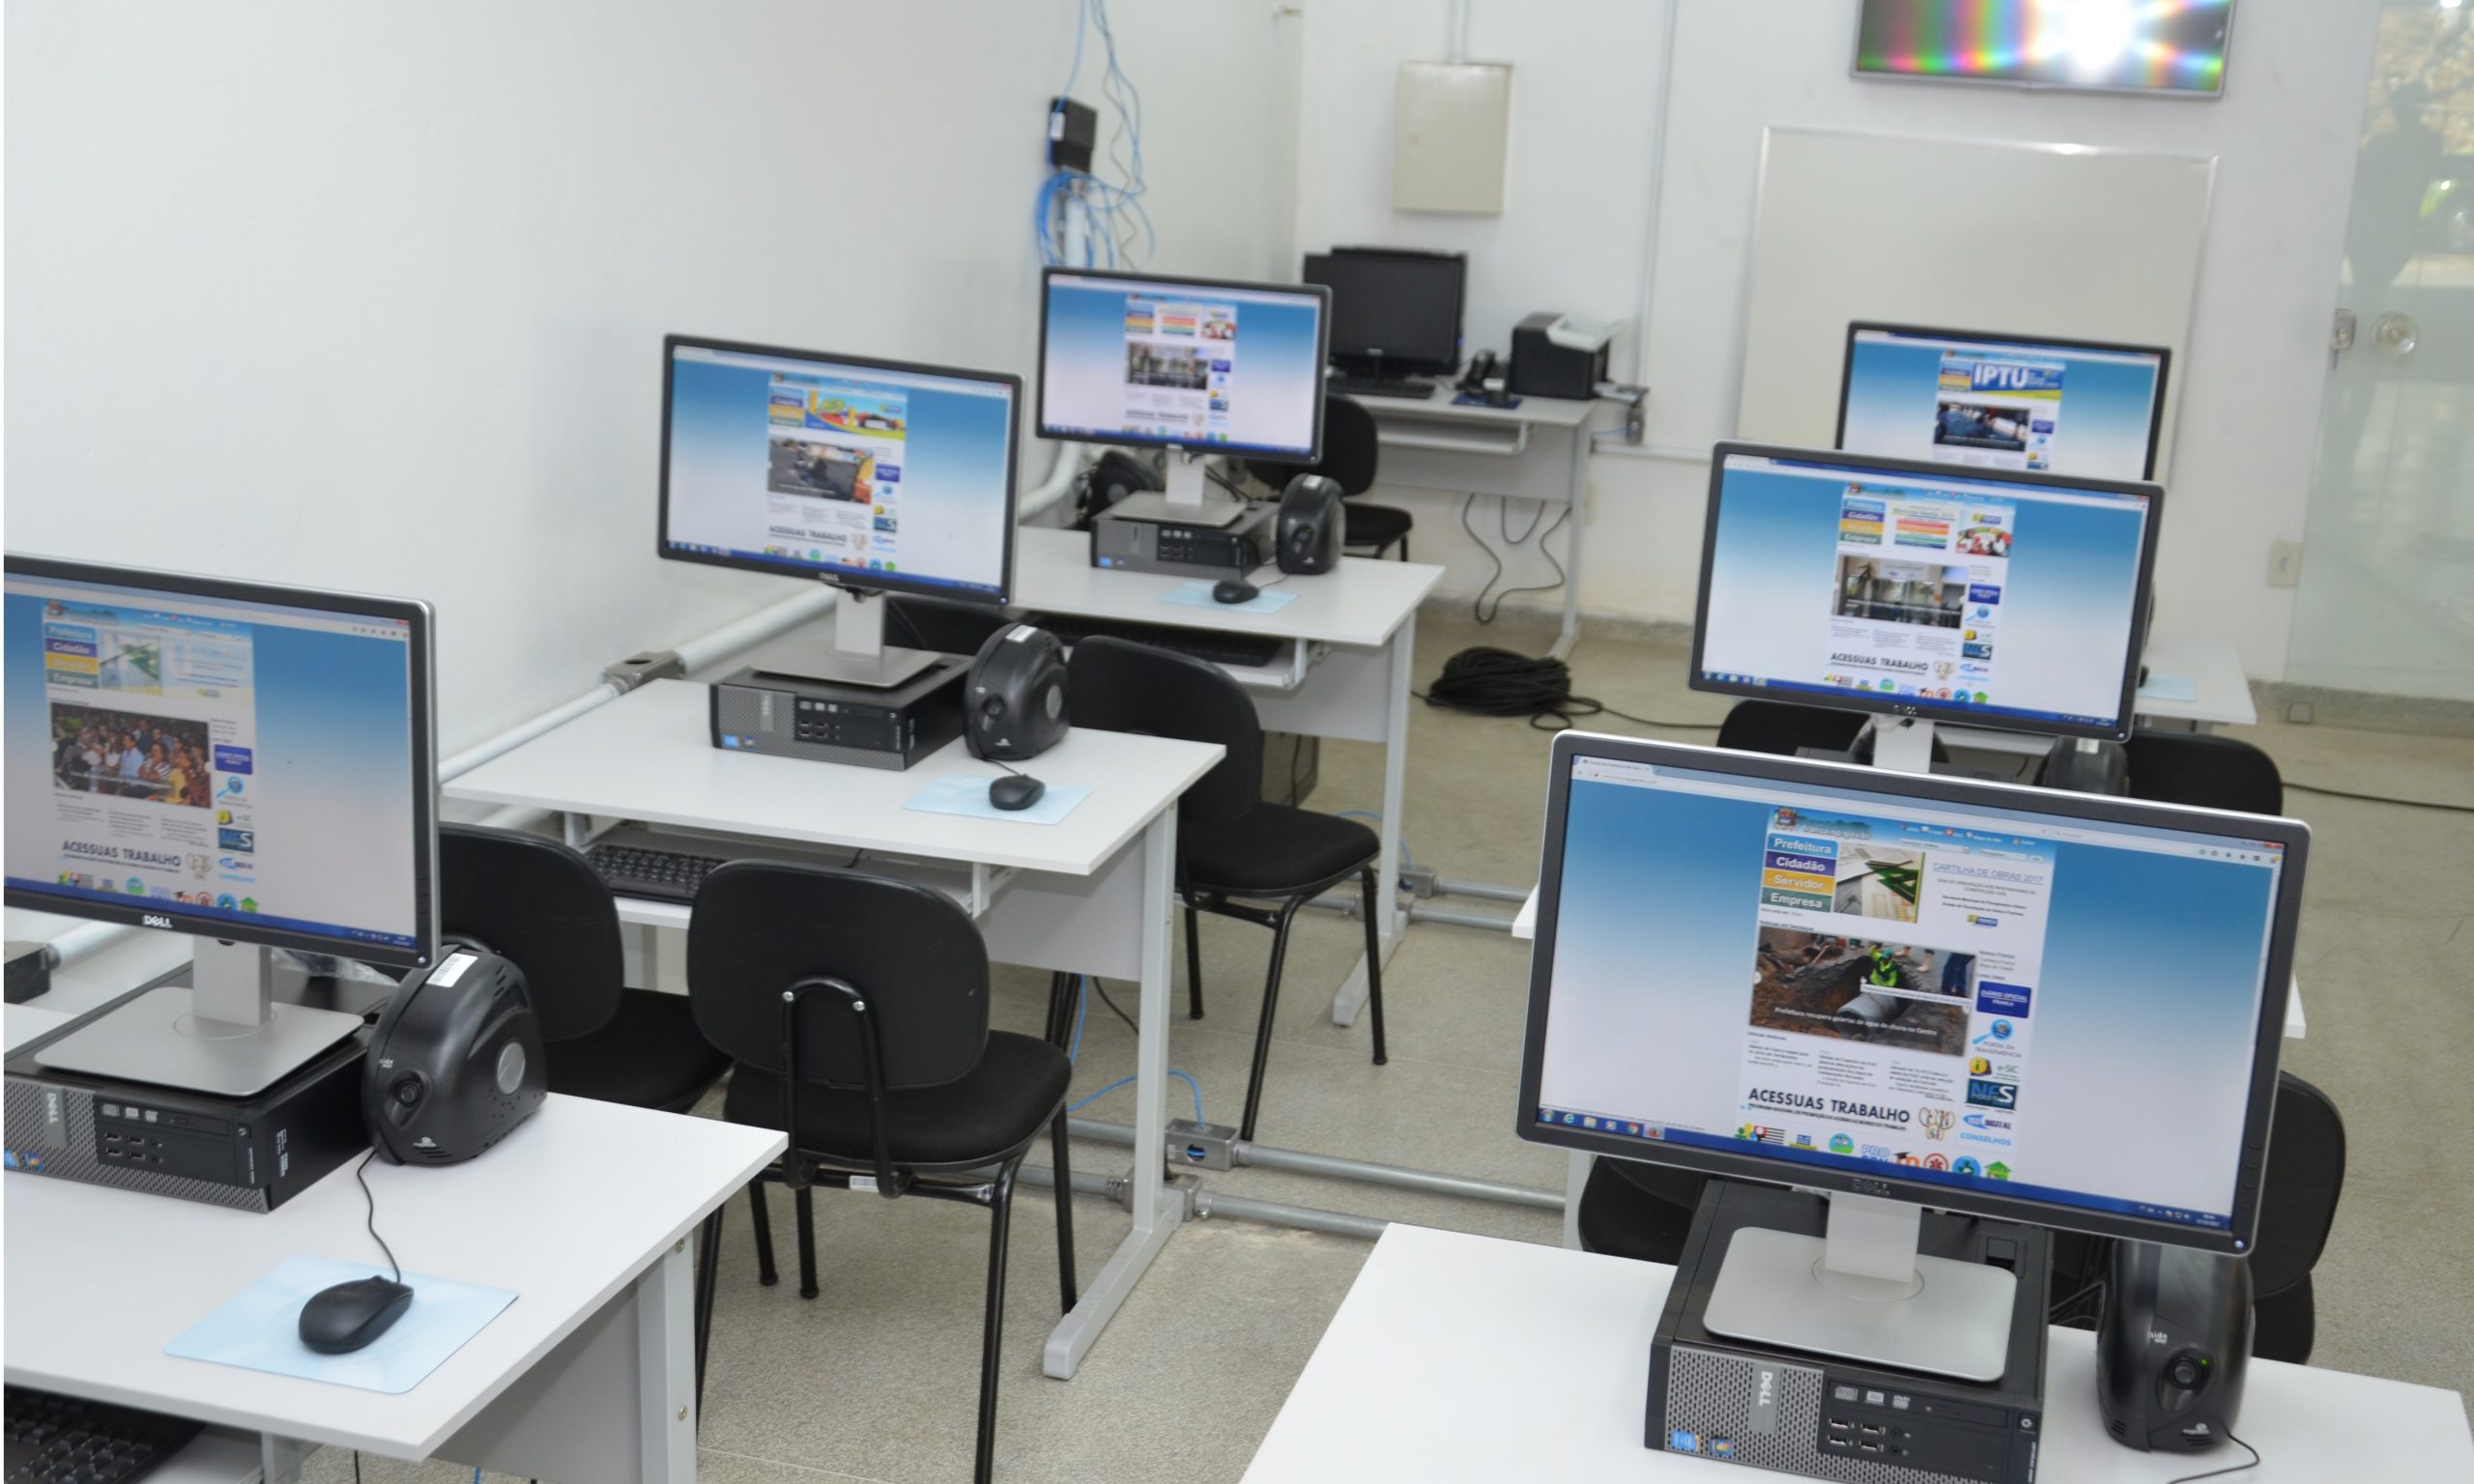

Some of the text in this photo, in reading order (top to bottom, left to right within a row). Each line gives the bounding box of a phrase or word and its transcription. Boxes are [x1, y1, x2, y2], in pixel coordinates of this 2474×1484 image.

[1974, 363, 2028, 388] IPTU
[1881, 658, 1929, 671] TRABALHO
[62, 841, 182, 867] ACESSUAS TRABALHO
[1773, 837, 1832, 854] Prefeitura
[1775, 855, 1826, 872] Cidadão
[1932, 862, 1975, 874] CARTILHA
[1992, 870, 2021, 881] OBRAS
[2023, 874, 2043, 884] 2017
[1773, 874, 1825, 890] Servidor
[1769, 892, 1823, 909] Empresa
[143, 914, 173, 928] DELL
[1774, 1007, 1804, 1015] Prefeitura
[47, 1092, 58, 1124] DELL
[1748, 1087, 1911, 1123] ACESSUAS TRABALHO
[1960, 1131, 2011, 1146] CONSELHOS
[1860, 1144, 1890, 1157] PRO
[1759, 1371, 1773, 1407] DELL
